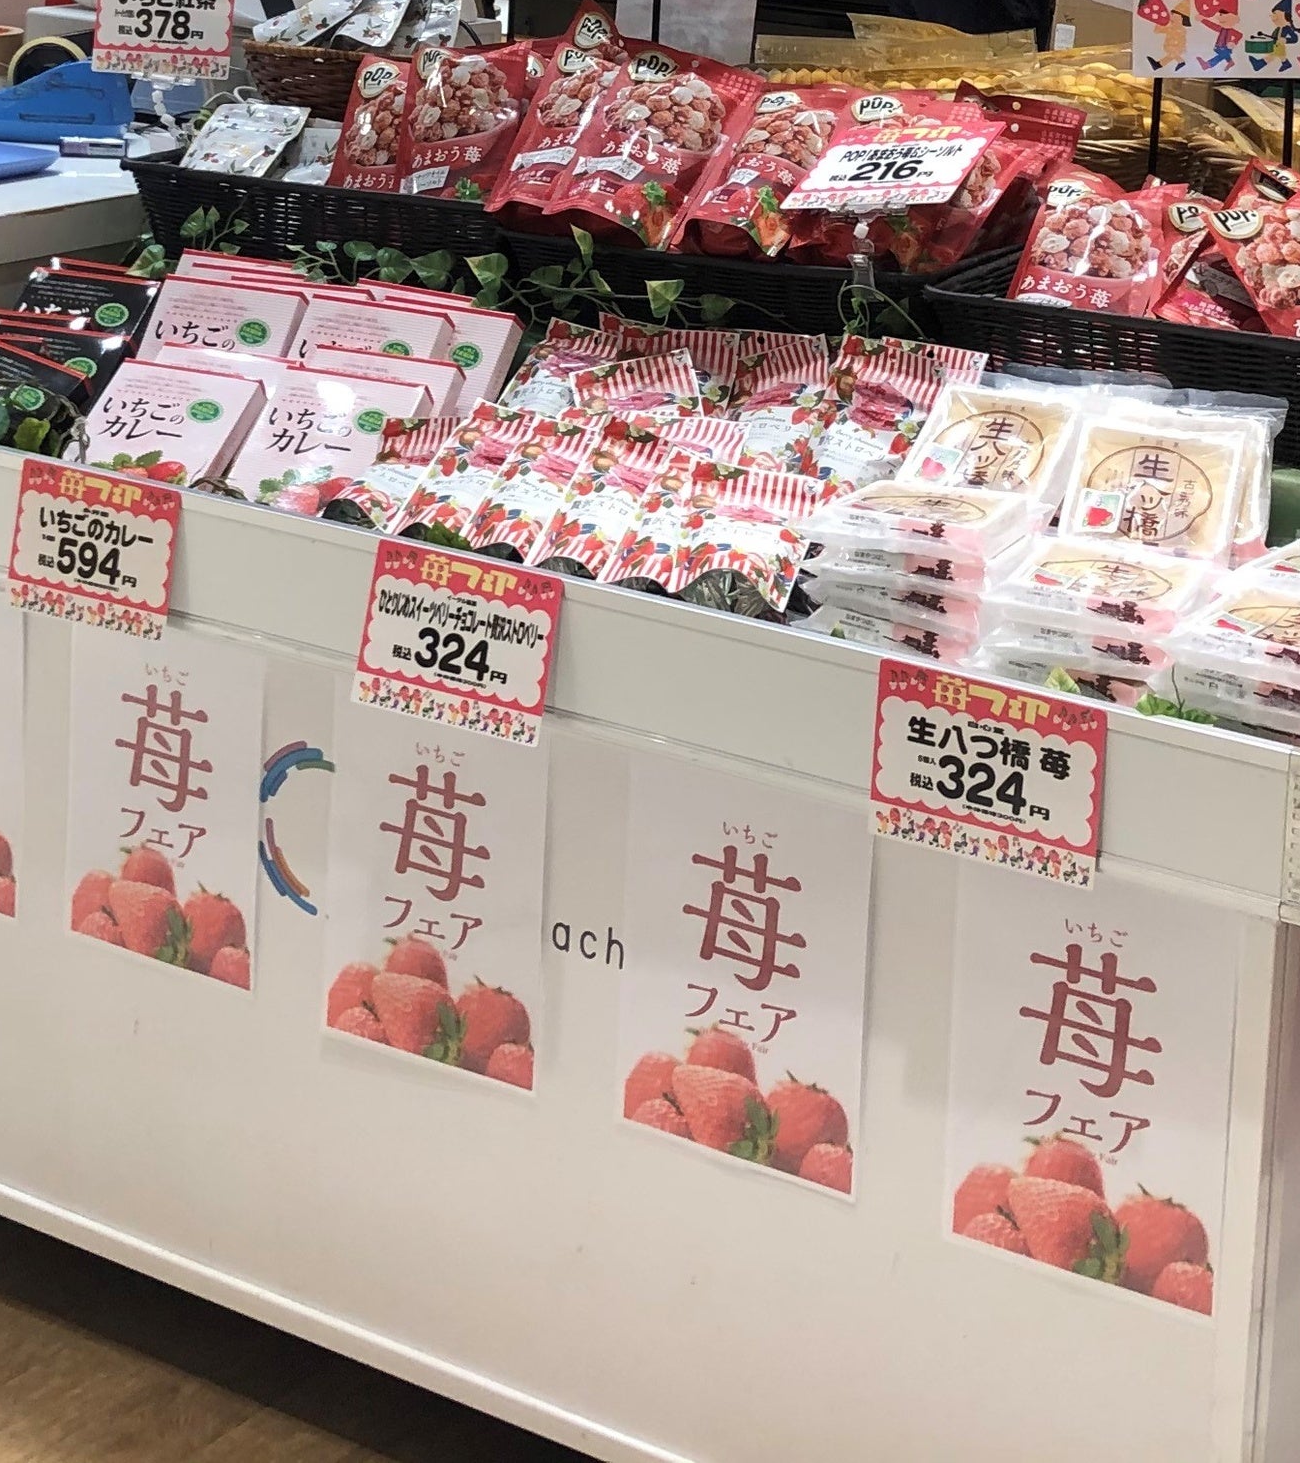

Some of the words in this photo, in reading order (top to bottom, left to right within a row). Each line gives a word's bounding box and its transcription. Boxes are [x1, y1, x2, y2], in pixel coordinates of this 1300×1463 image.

[1019, 275, 1113, 309] あまおう苺
[100, 416, 184, 441] カレー
[103, 396, 185, 426] いちごの
[266, 427, 353, 456] カレー
[39, 506, 154, 548] いちごのカレー
[144, 662, 190, 687] いちご
[114, 684, 214, 813] 苺
[414, 741, 466, 767] いちご
[906, 715, 1032, 771] 生八つ橋
[1039, 745, 1072, 781] 苺
[119, 806, 207, 859] フェア
[379, 764, 491, 902] 苺
[721, 821, 779, 849] いちご
[382, 895, 484, 951] フェア
[682, 845, 807, 992] 苺
[1064, 917, 1129, 948] いちご
[684, 983, 797, 1044] フェア
[1018, 943, 1163, 1099] 苺
[1022, 1088, 1151, 1154] フェア
